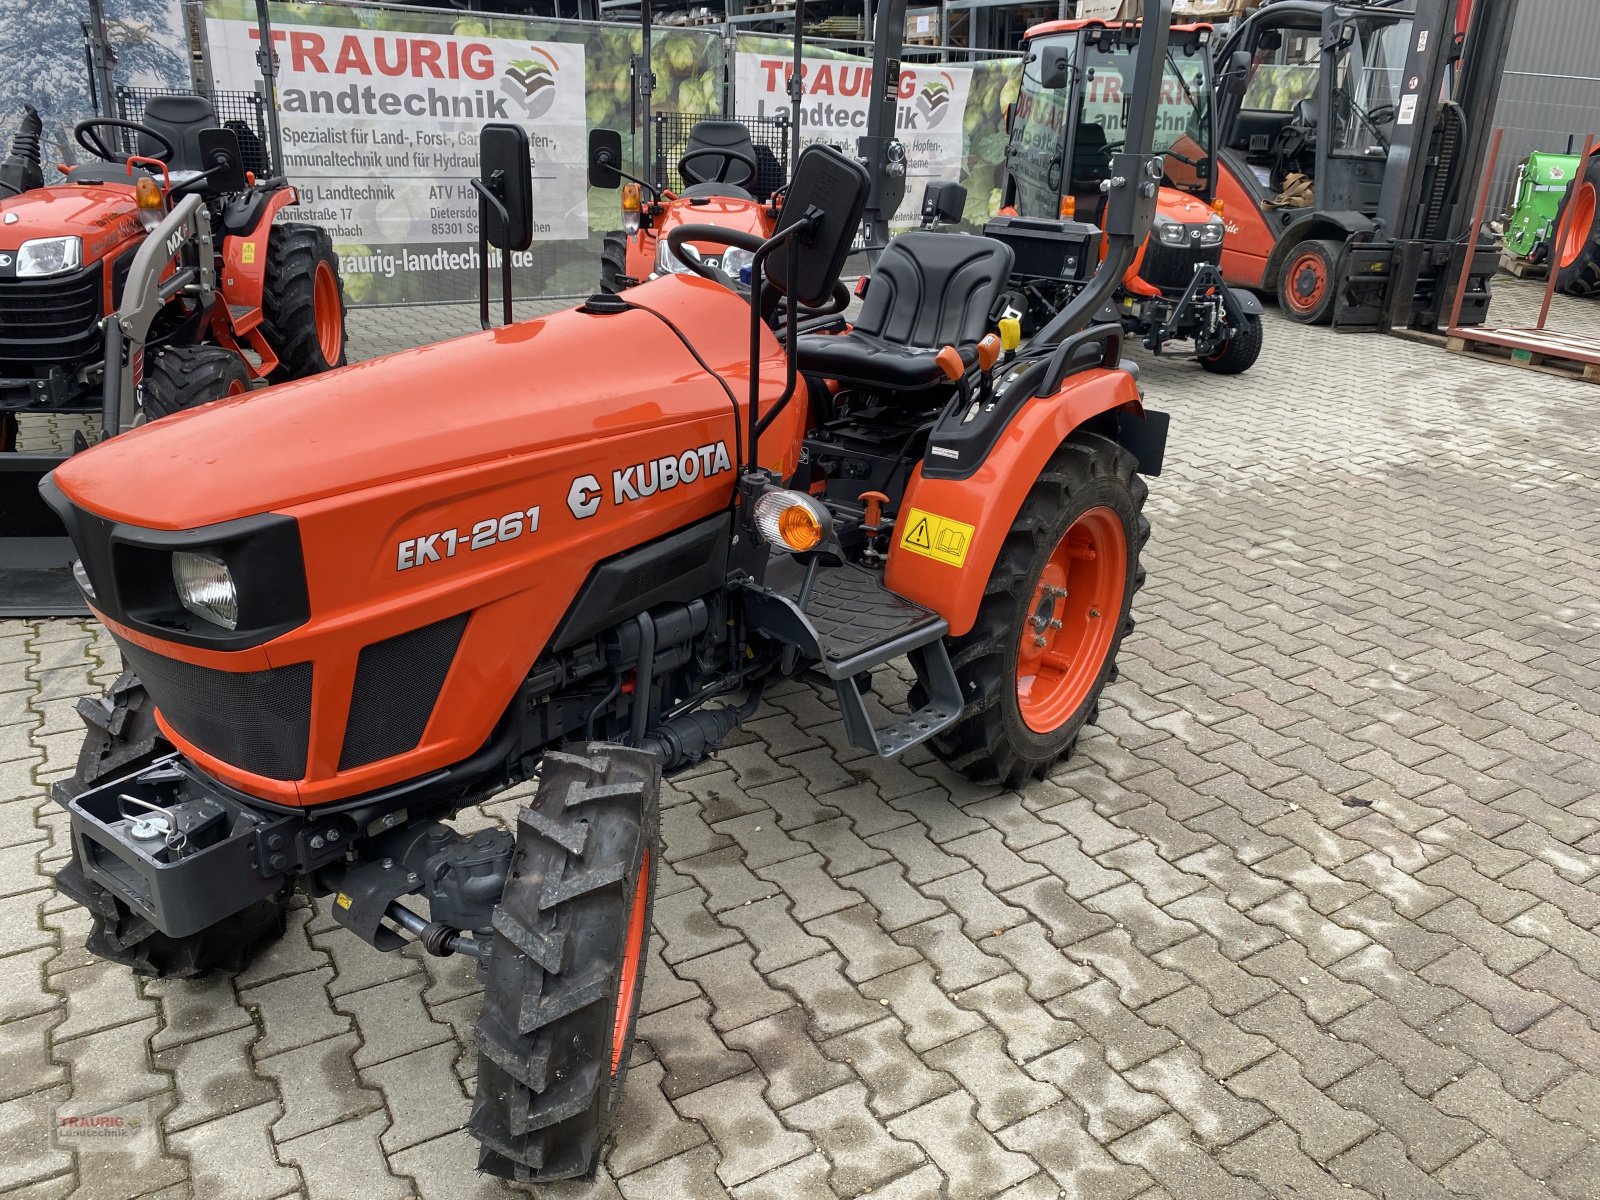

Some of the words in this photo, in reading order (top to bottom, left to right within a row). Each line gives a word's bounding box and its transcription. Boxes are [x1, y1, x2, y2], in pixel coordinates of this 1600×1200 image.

[248, 28, 495, 80] TRAURIG
[282, 126, 348, 147] Spezialist
[350, 127, 369, 145] für
[458, 131, 481, 147] Gar
[282, 150, 382, 168] mmunaltechnik
[385, 152, 410, 168] und
[413, 152, 430, 168] für
[317, 184, 396, 200] Landtechnik
[429, 186, 453, 200] ATV
[276, 207, 338, 221] abrikstraße
[340, 208, 353, 221] 17
[430, 207, 478, 219] Dietersdo
[431, 222, 463, 235] 85301
[166, 226, 184, 255] MX
[611, 440, 732, 505] KUBOTA
[396, 505, 541, 571] EK1-261
